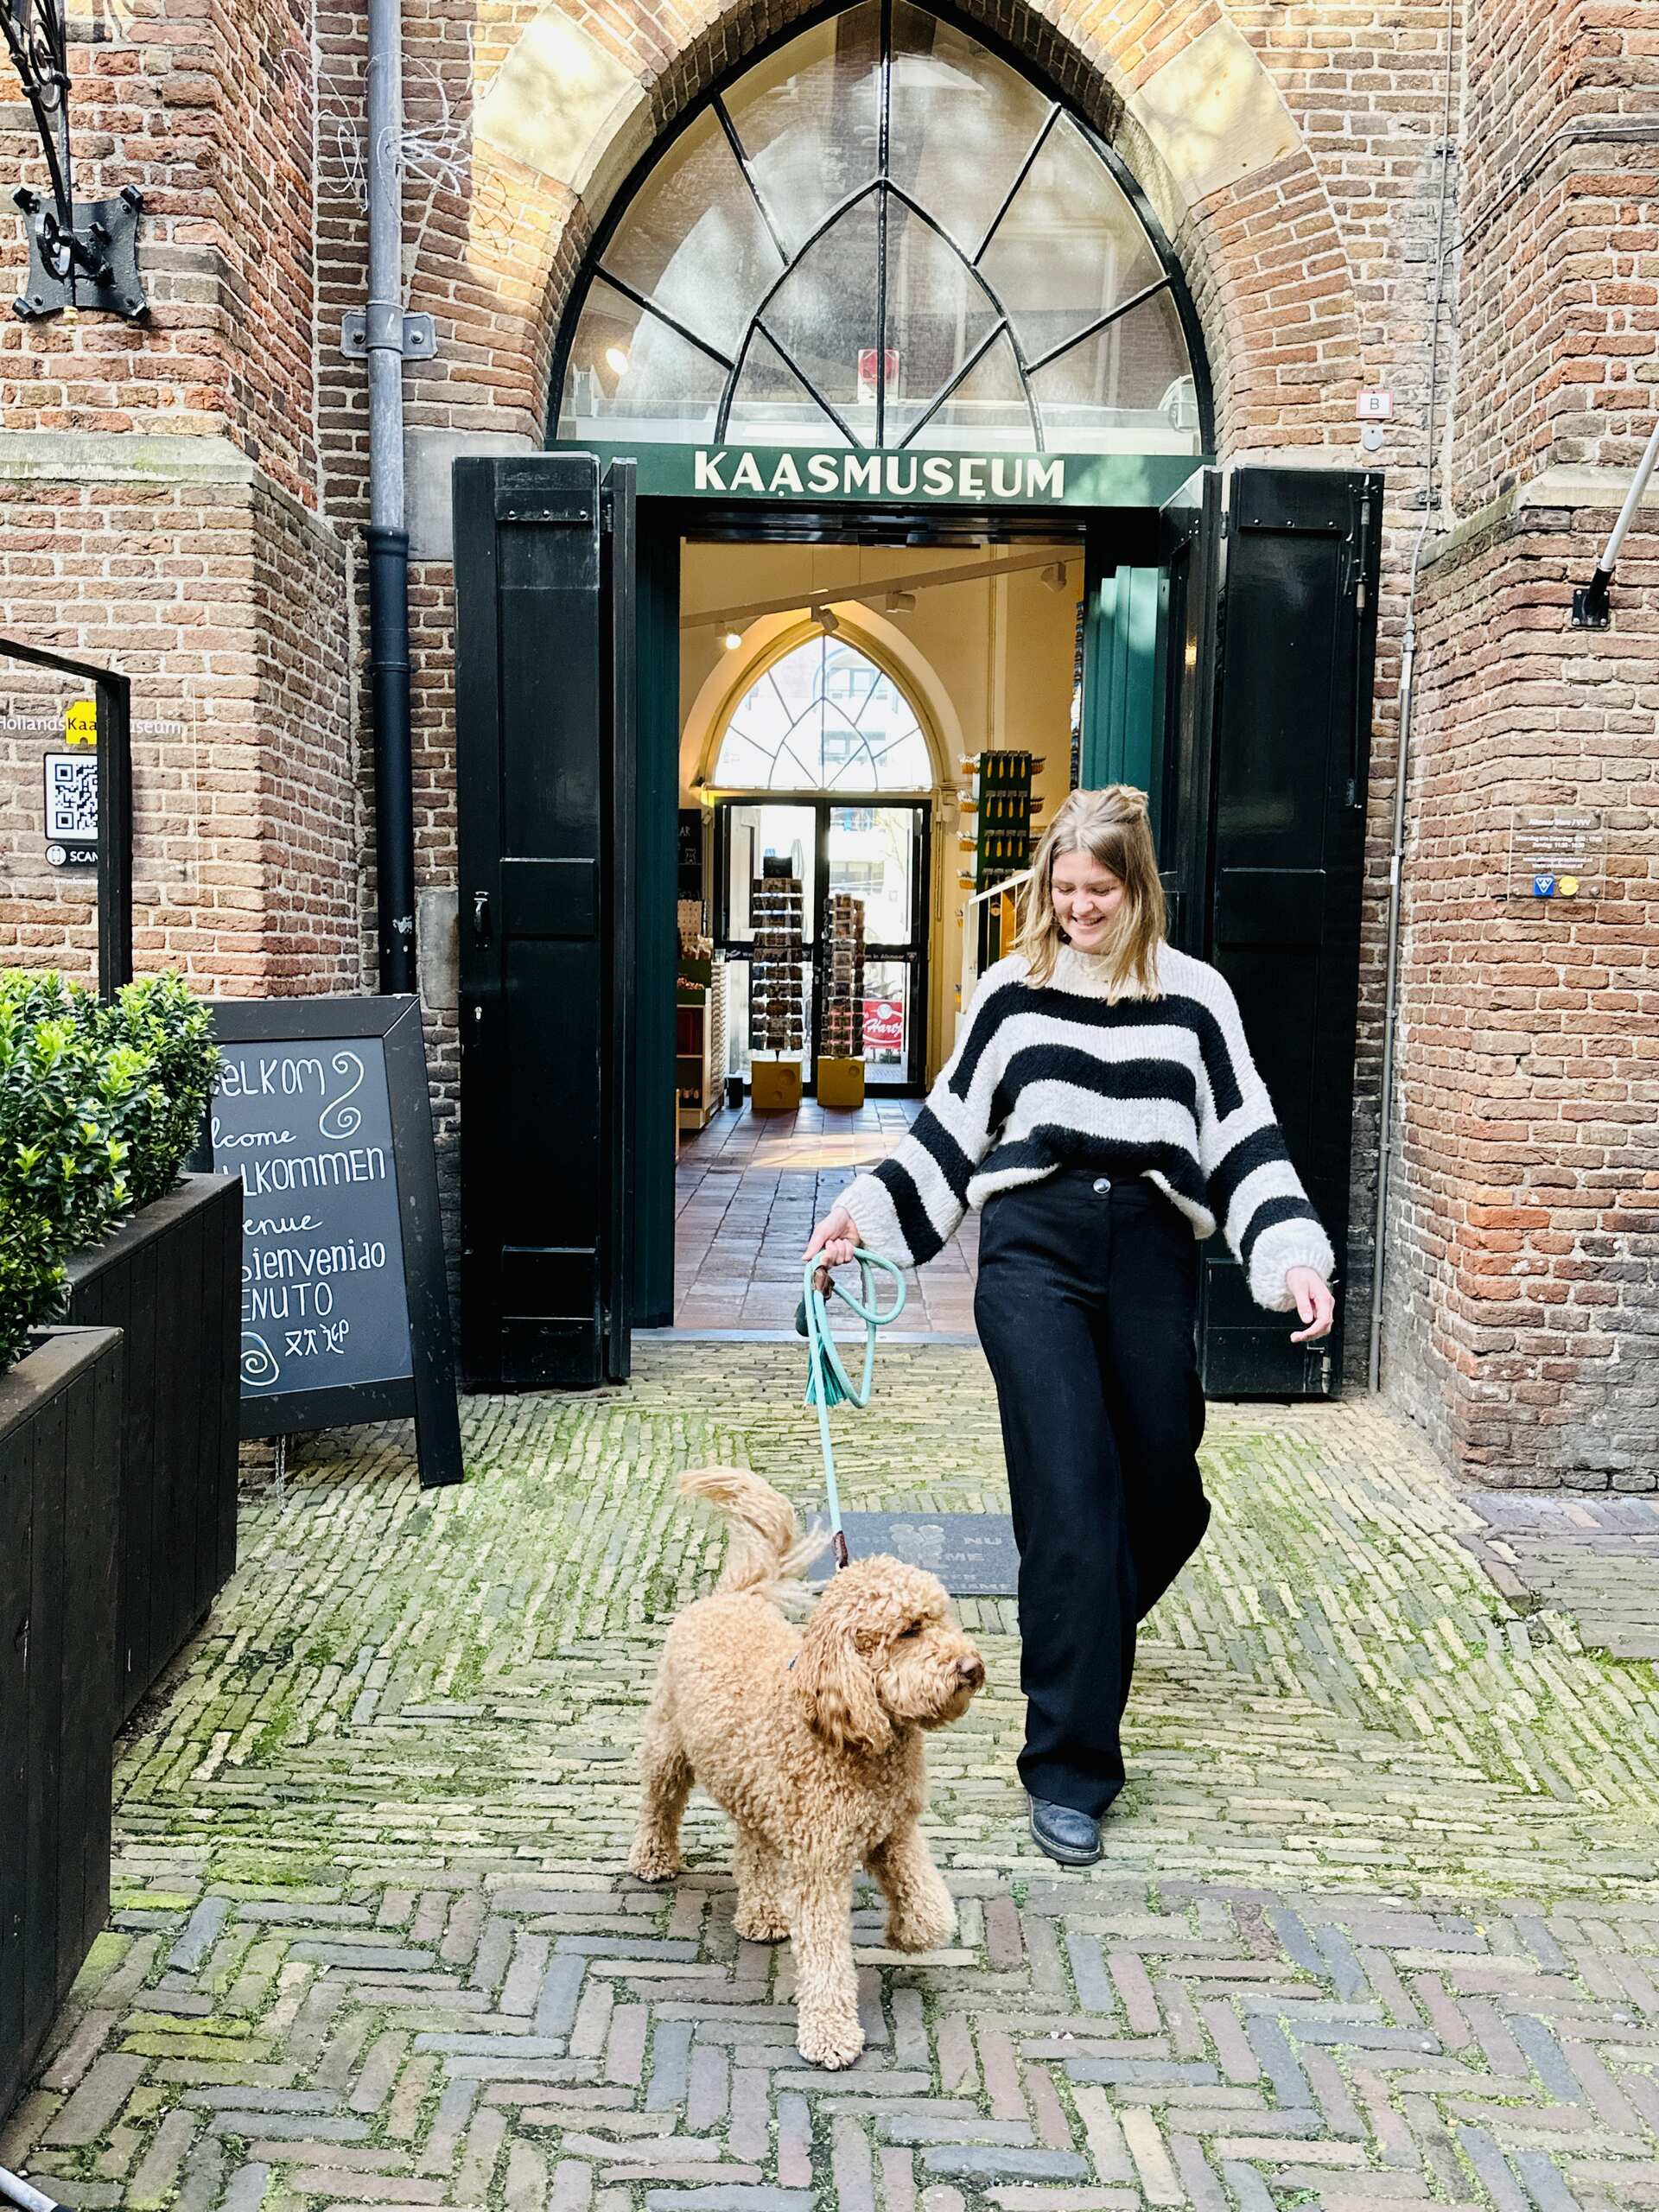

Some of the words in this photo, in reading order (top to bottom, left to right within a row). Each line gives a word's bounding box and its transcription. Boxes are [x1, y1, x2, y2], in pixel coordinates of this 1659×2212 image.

[1370, 397, 1380, 410] B
[694, 450, 1065, 499] KAASMUSEUM
[214, 1058, 326, 1097] eLKOM
[210, 1116, 296, 1149] lcome
